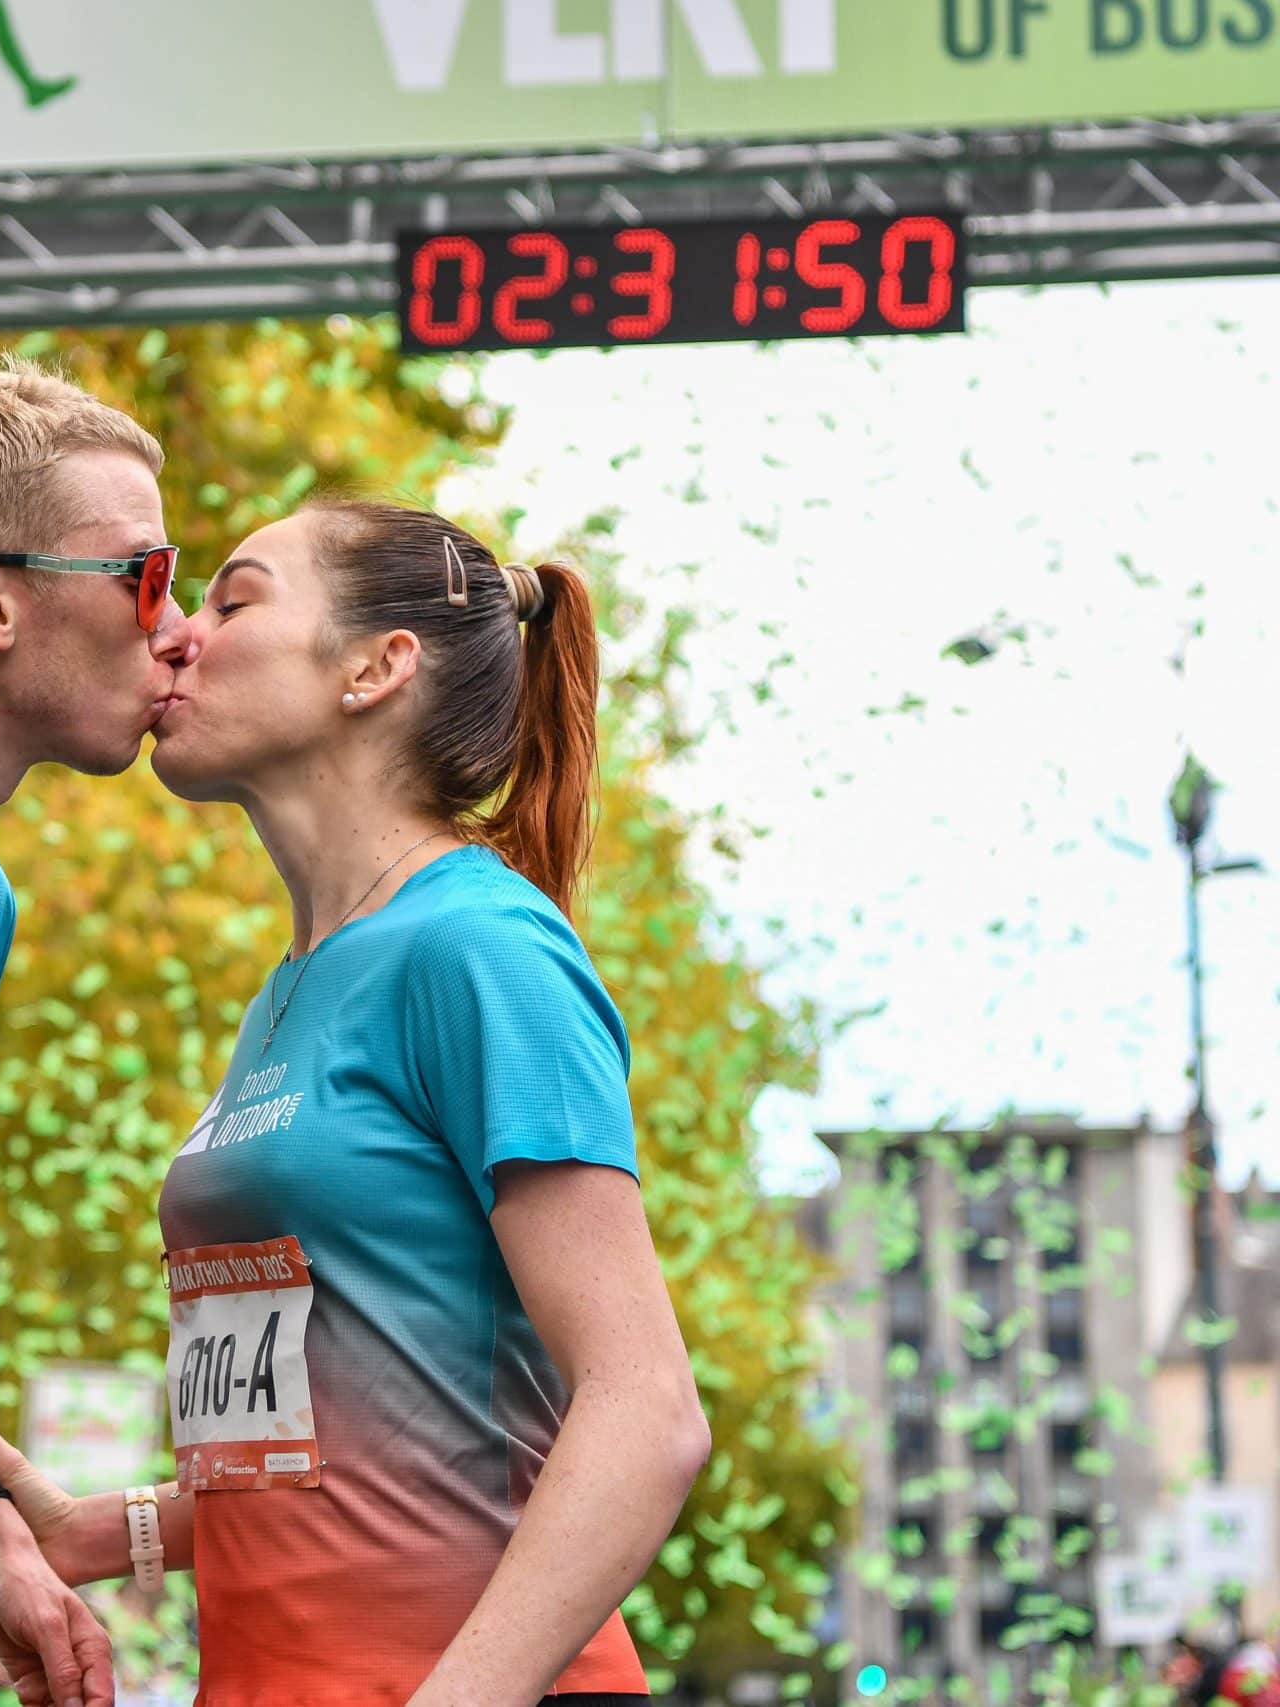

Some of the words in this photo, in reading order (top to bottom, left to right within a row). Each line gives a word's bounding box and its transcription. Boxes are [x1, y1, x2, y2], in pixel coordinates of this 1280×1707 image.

[237, 1062, 287, 1102] tonton
[211, 1095, 290, 1149] OUTDOOR
[170, 1260, 233, 1293] MARATHON
[228, 1257, 260, 1284] DUO
[256, 1253, 294, 1280] 2025
[179, 1311, 280, 1422] 6710-A
